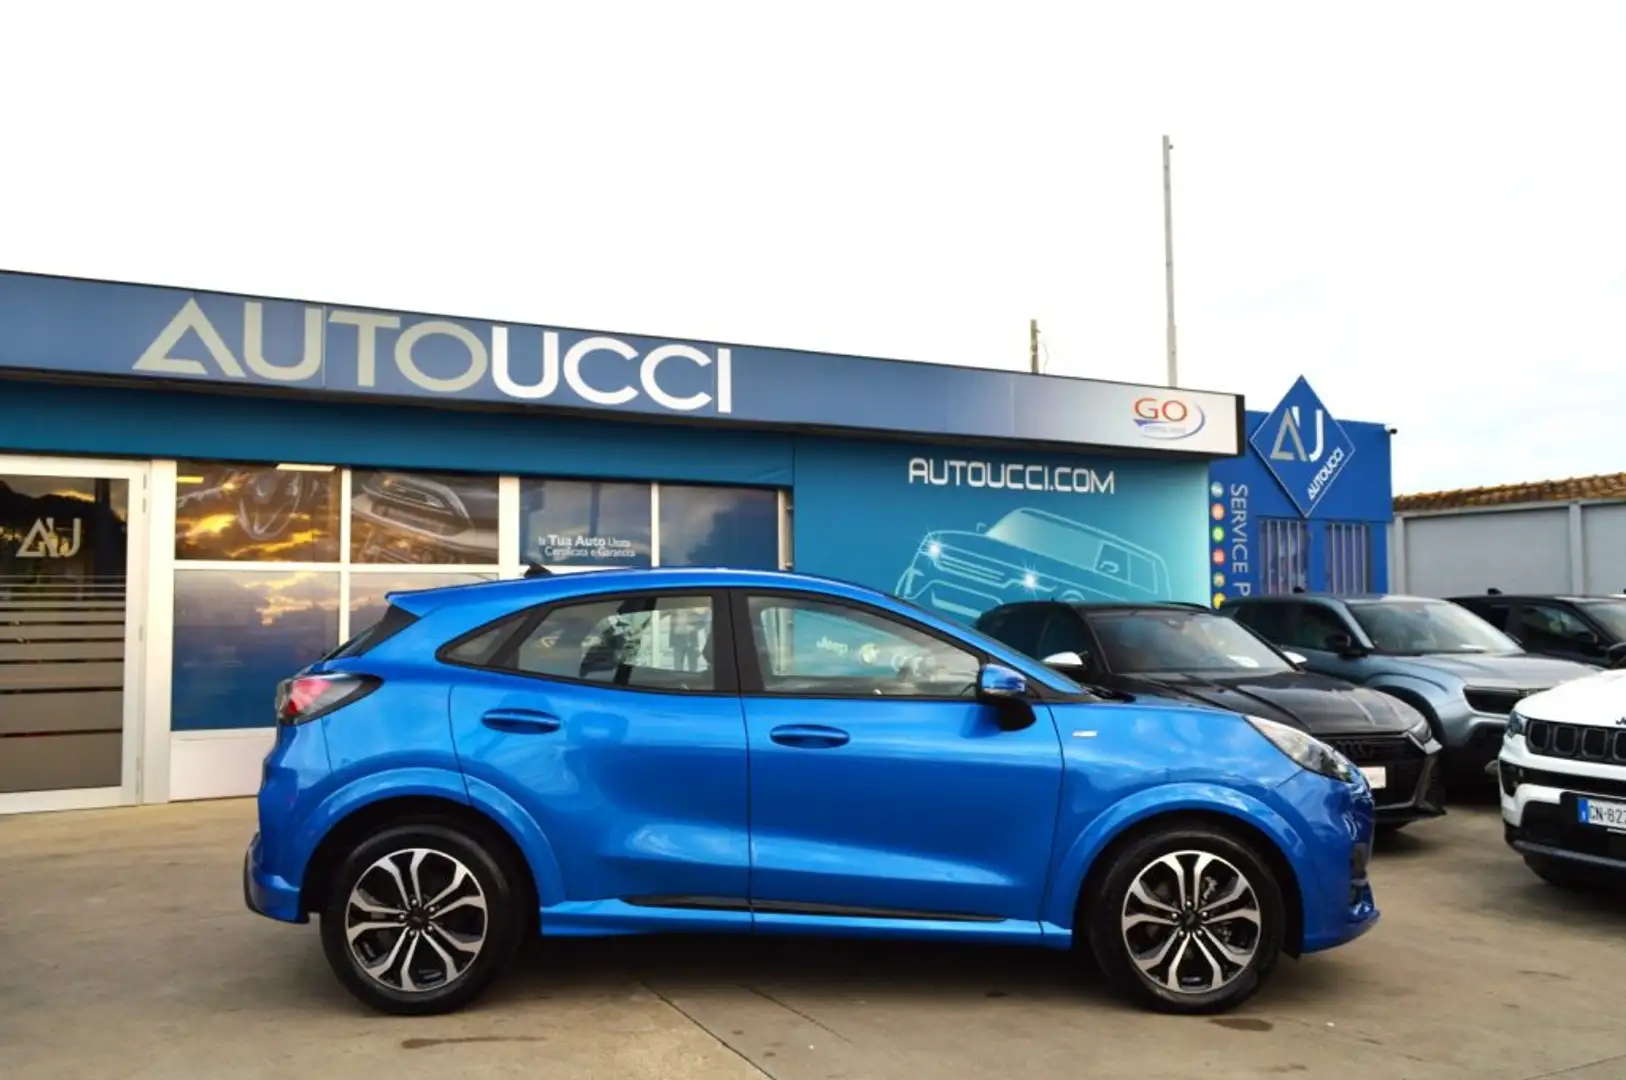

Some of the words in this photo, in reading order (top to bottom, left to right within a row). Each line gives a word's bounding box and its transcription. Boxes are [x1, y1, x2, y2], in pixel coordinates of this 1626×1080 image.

[131, 298, 733, 413] AUTOUCCI
[1134, 397, 1188, 422] GO
[908, 457, 1116, 495] AUTOUCCI.COM
[1307, 446, 1345, 501] AUTOUCCI
[547, 534, 572, 546] Tua
[574, 535, 606, 547] Auto
[1230, 483, 1248, 573] SERVICE
